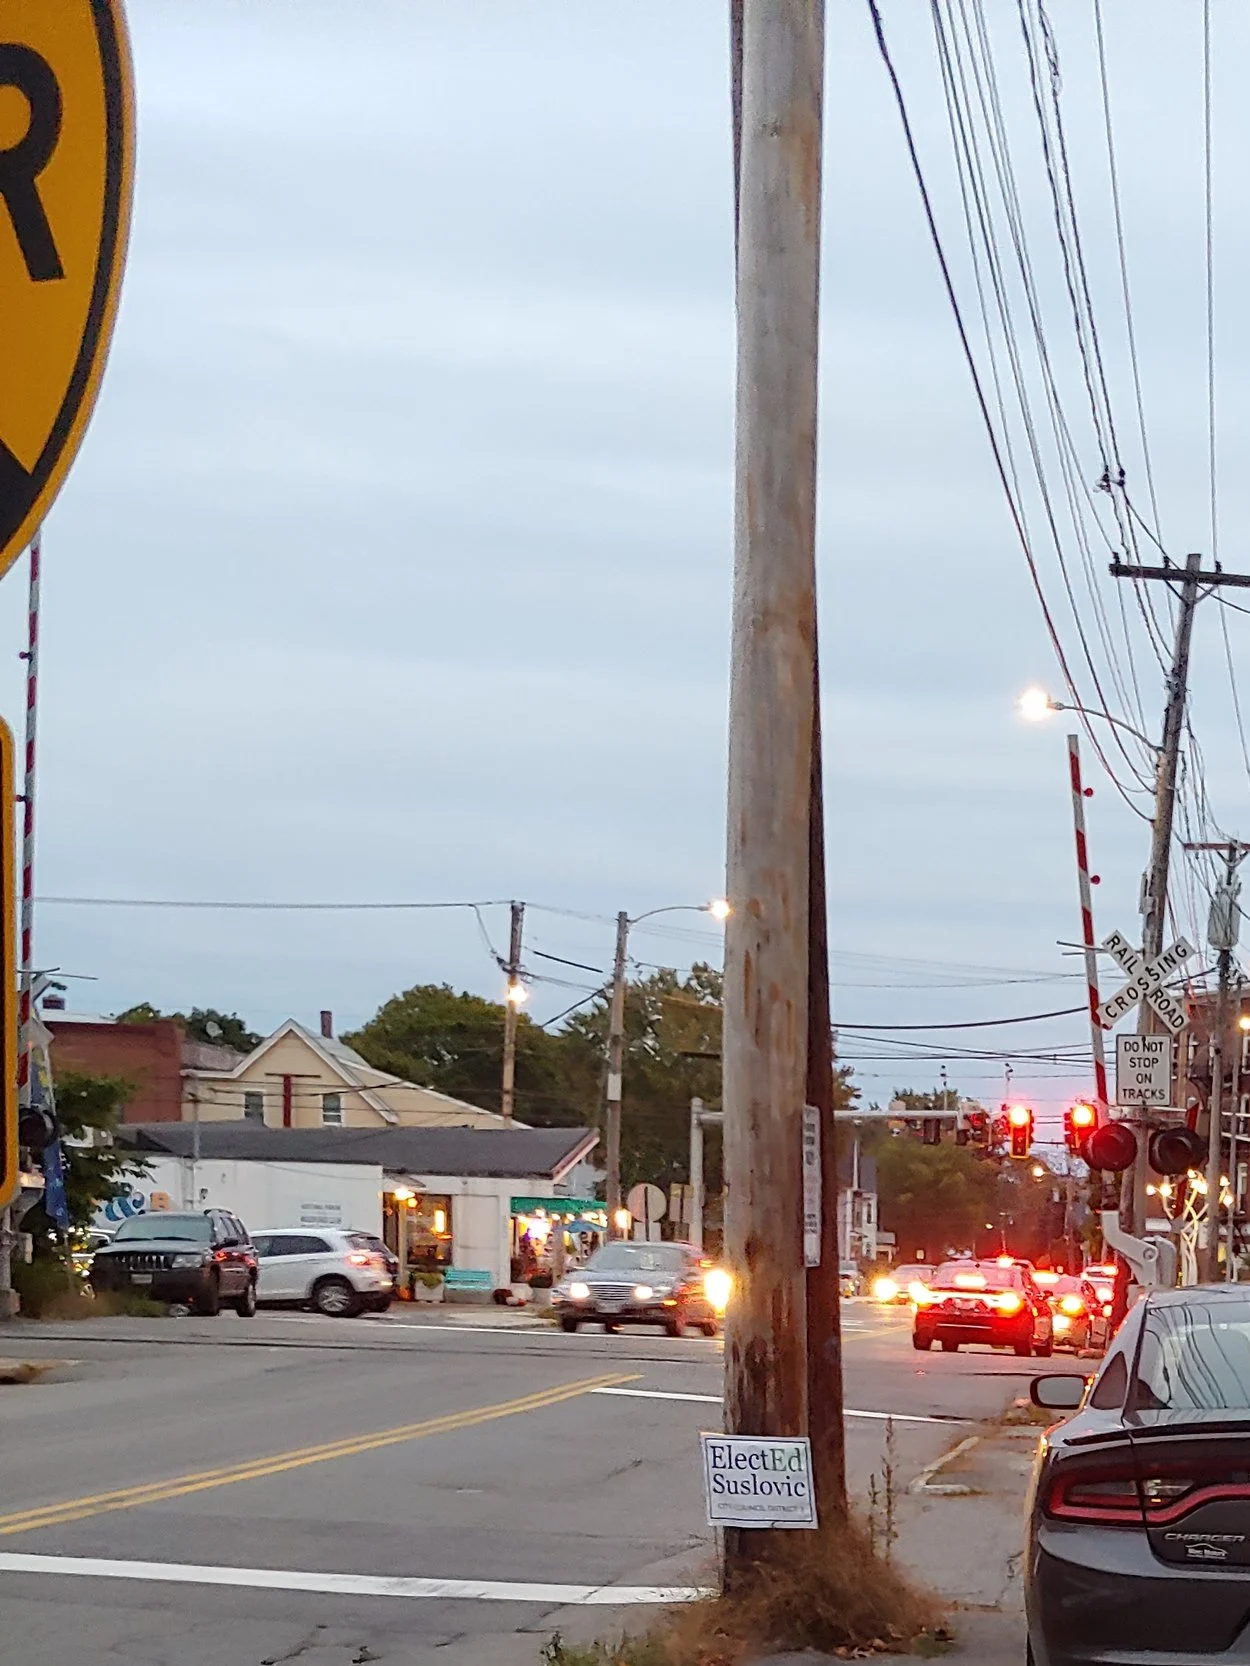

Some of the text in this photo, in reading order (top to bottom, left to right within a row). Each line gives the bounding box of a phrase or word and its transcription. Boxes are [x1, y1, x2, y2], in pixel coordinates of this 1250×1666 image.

[1105, 944, 1188, 1019] CROSSING
[1106, 934, 1185, 1029] RAIL ROAD
[1124, 1041, 1164, 1053] DO NOT
[1129, 1057, 1159, 1069] STOP
[1136, 1073, 1152, 1084] ON
[1122, 1088, 1166, 1100] TRACKS
[712, 1473, 806, 1497] Suslovic
[1164, 1533, 1245, 1542] CHARGER
